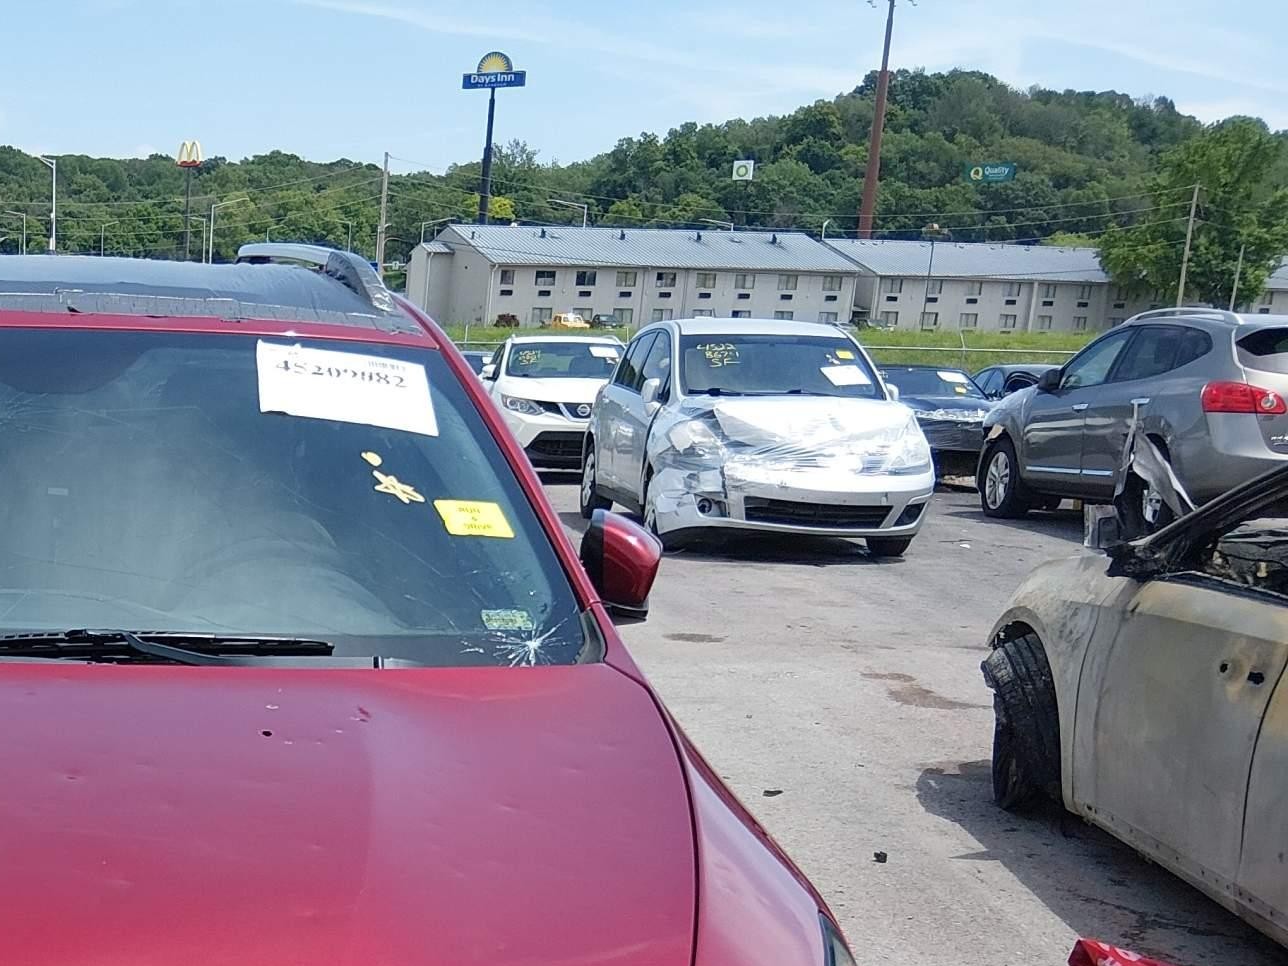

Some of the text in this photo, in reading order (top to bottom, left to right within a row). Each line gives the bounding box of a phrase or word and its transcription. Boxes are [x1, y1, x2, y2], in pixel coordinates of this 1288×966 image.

[470, 73, 515, 84] Days Inn
[984, 166, 1010, 176] Quality
